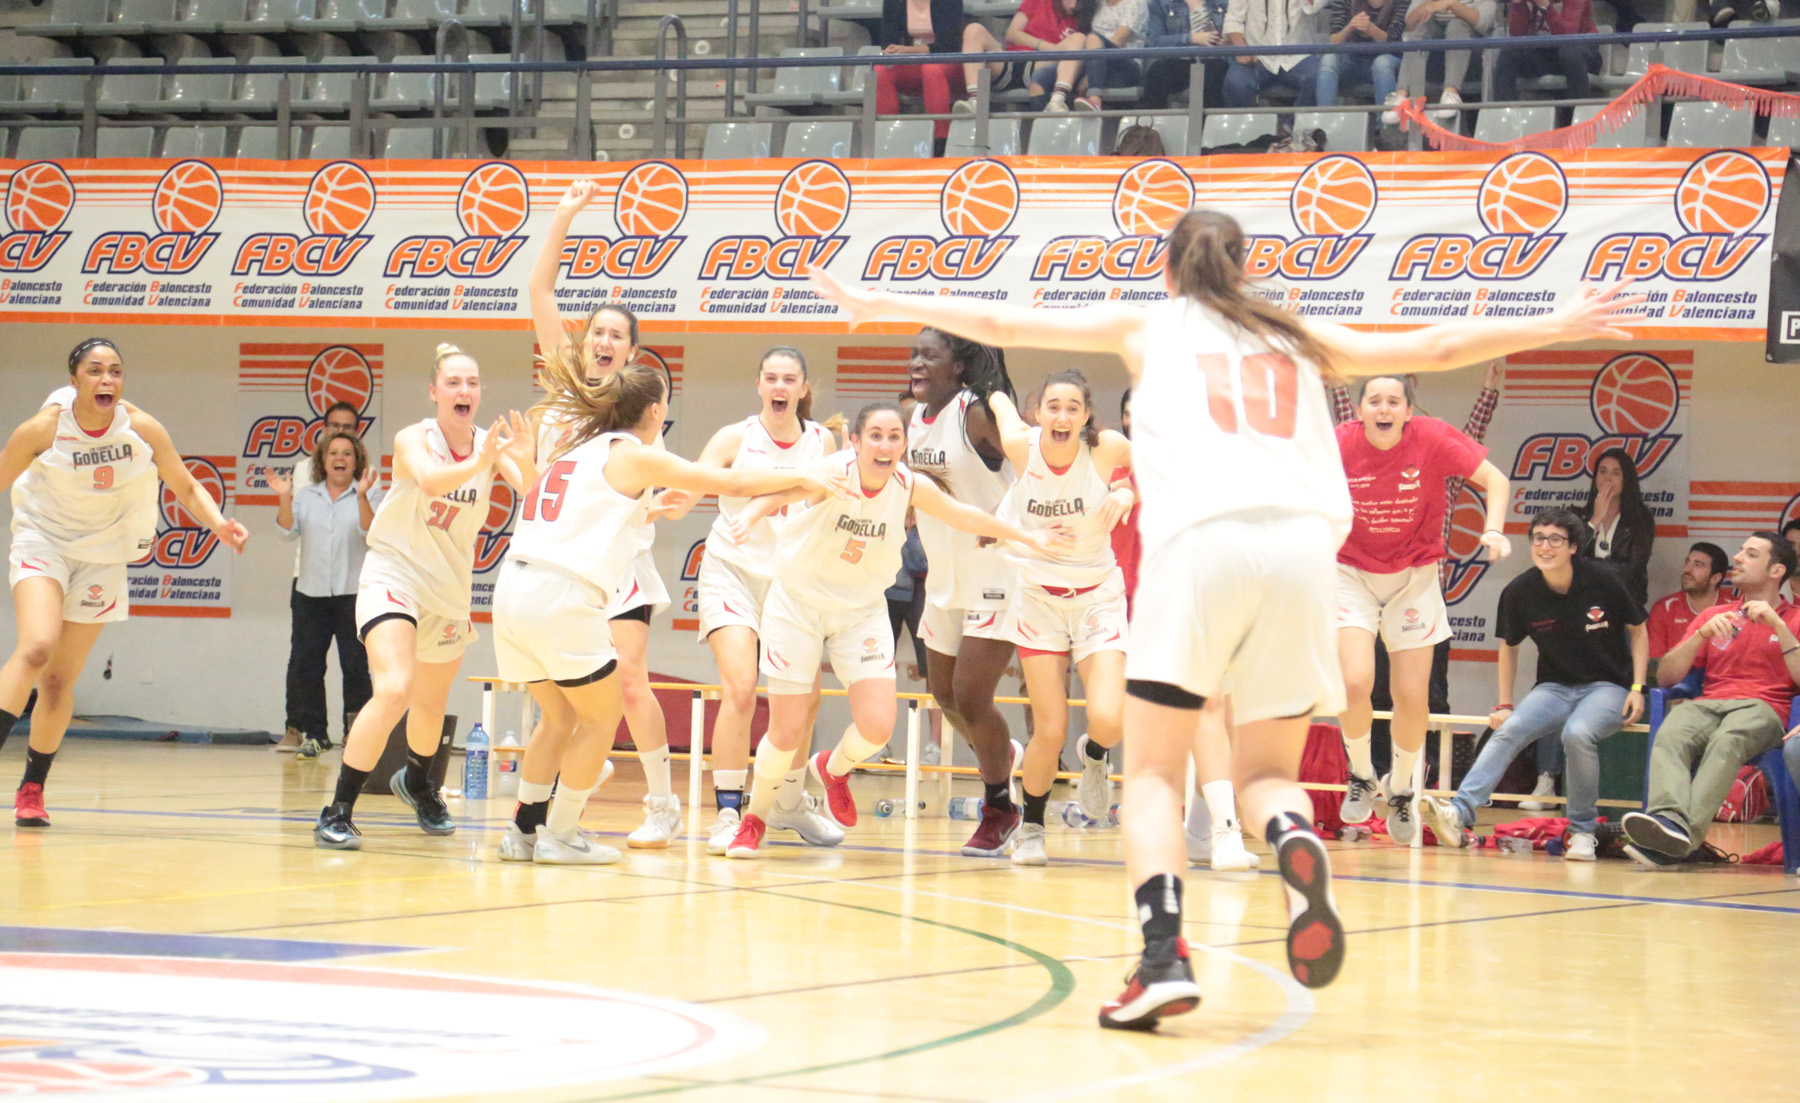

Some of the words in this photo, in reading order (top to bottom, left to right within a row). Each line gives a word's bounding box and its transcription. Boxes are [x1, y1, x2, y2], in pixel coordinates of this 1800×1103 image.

[0, 231, 72, 273] CV
[81, 231, 222, 274] FBCV
[231, 233, 375, 276] FBCV
[383, 235, 530, 278] FBCV
[697, 235, 851, 280] FBCV
[861, 235, 1020, 281] FBCV
[1030, 235, 1171, 281] FBCV
[1242, 233, 1375, 280] BCV
[1388, 232, 1568, 281] FBCV
[1580, 232, 1771, 282] FBCV
[1, 279, 62, 291] Baloncesto
[84, 280, 146, 292] Federación
[150, 281, 212, 294] Baloncesto
[234, 282, 297, 294] Federación
[300, 283, 363, 295] Baloncesto
[386, 284, 450, 296] Federación
[454, 284, 518, 297] Baloncesto
[0, 293, 61, 305] Valenciana
[554, 287, 607, 298] ederación
[611, 286, 677, 299] Baloncesto
[700, 286, 769, 299] Federación
[1033, 287, 1106, 300] Federación
[1109, 287, 1169, 300] Balonces
[1288, 287, 1364, 300] Baloncesto
[1392, 288, 1471, 301] Federación
[1475, 288, 1555, 302] Baloncesto
[1672, 289, 1757, 303] Baloncesto
[83, 293, 145, 306] Comunidad
[148, 294, 211, 307] Valenciana
[233, 295, 296, 308] Comunidad
[298, 296, 362, 309] Valenciana
[385, 298, 449, 310] Comunidad
[452, 299, 518, 311] Valenciana
[699, 300, 767, 313] Comunidad
[769, 301, 839, 314] Valenciana
[1286, 302, 1363, 316] Valenciana
[1390, 303, 1469, 316] Comunidad
[1473, 303, 1554, 317] Valenciana
[1669, 305, 1755, 319] Valenciana
[1195, 352, 1298, 439] 10
[243, 416, 375, 457] FBC
[72, 444, 133, 470] GODELLA
[93, 465, 114, 490] 9
[521, 460, 578, 522] 15
[1514, 487, 1591, 500] Federación
[1027, 497, 1085, 517] GODELLA
[427, 500, 461, 532] 21
[835, 514, 886, 540] GODELLA
[840, 538, 867, 565] 5
[162, 575, 221, 587] Baloncesto
[129, 587, 157, 598] nidad
[161, 588, 221, 600] Valenciana
[1448, 615, 1486, 627] cesto
